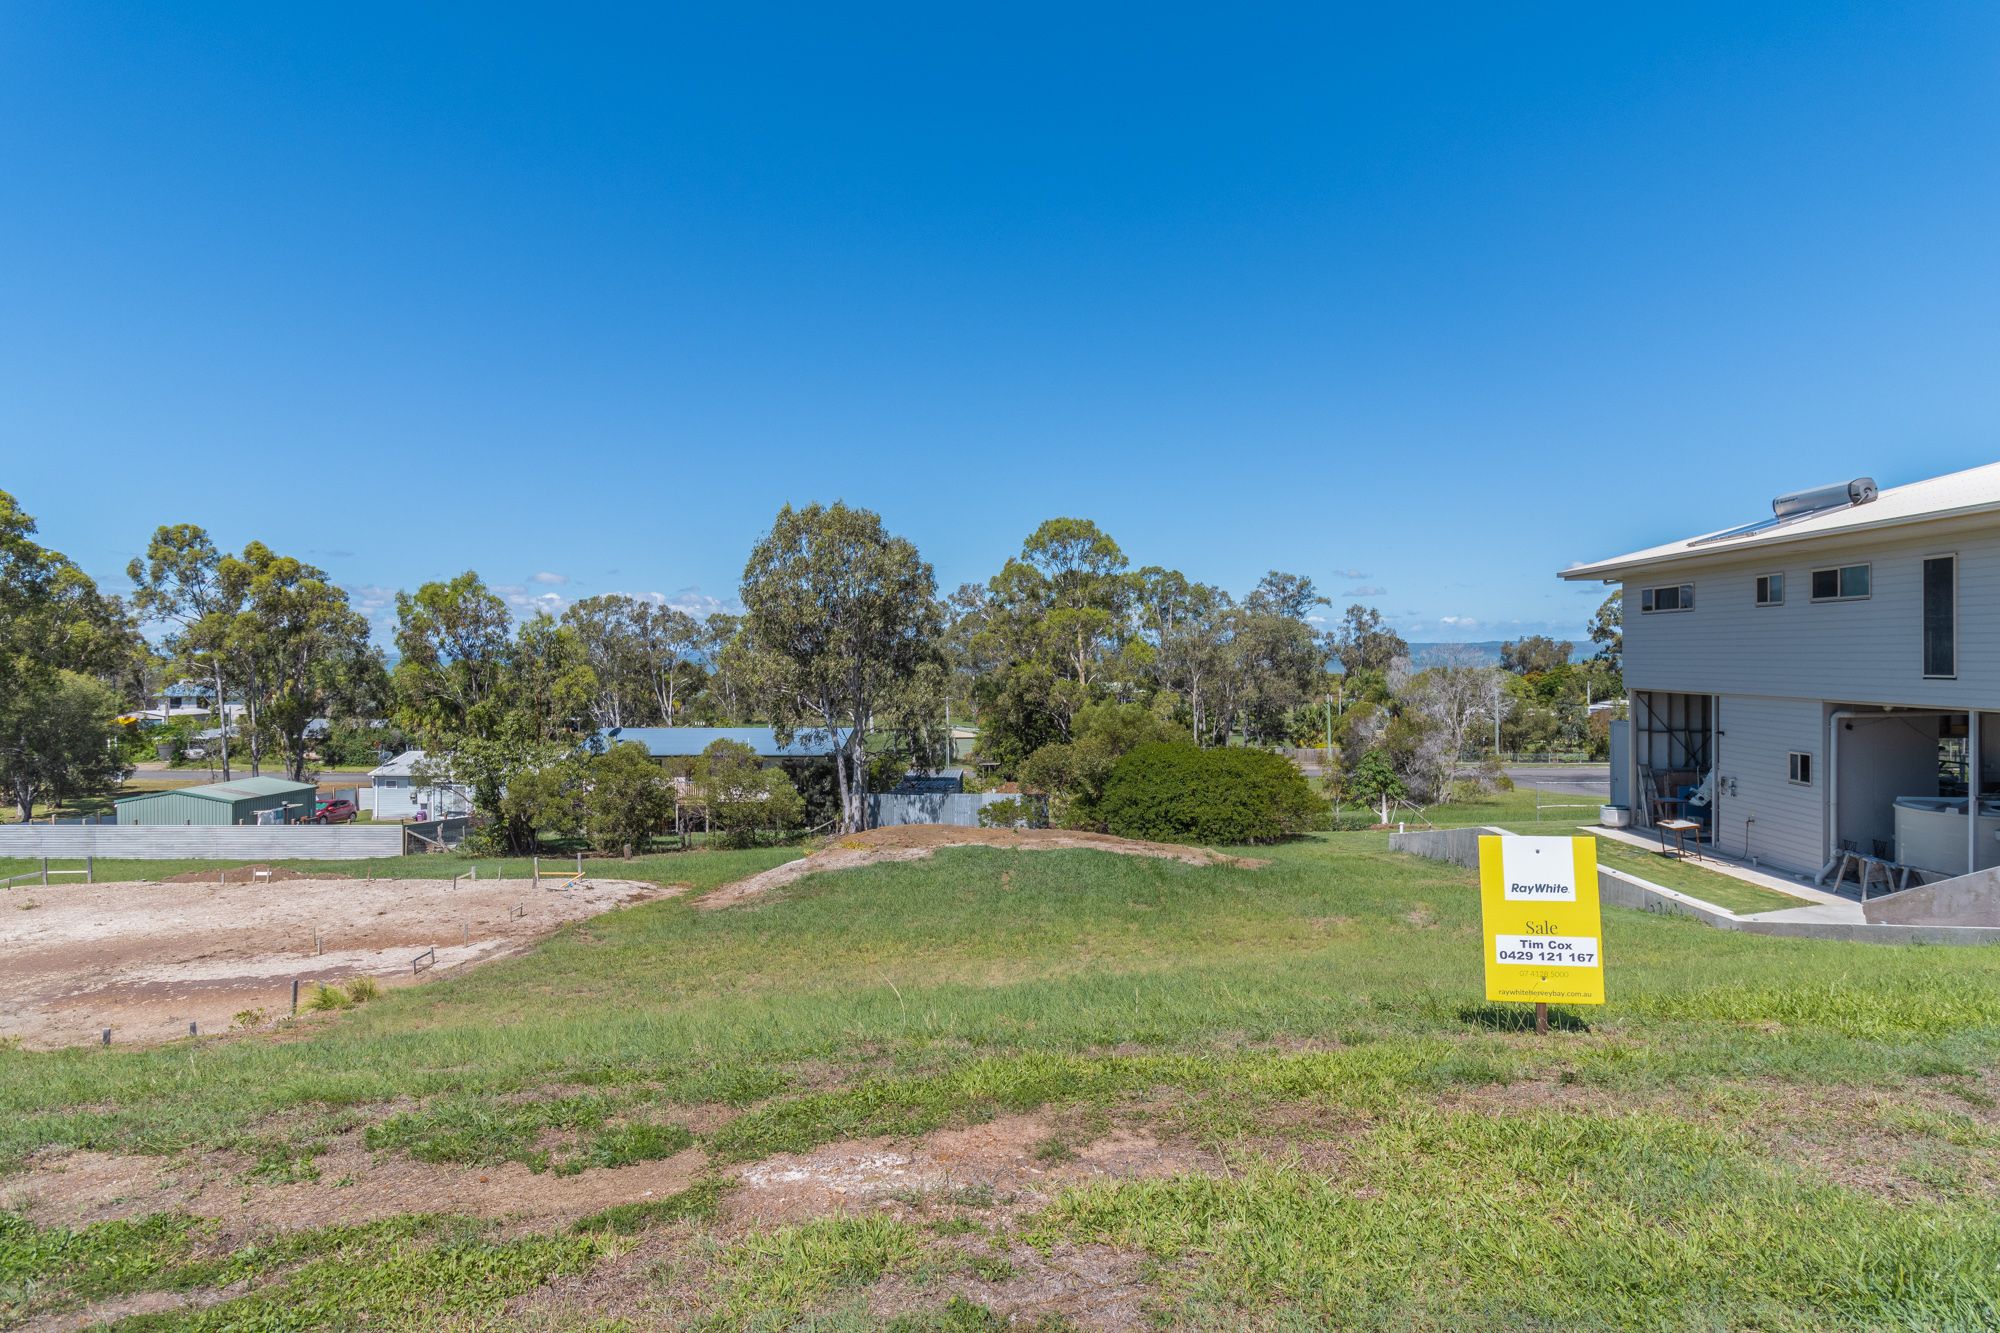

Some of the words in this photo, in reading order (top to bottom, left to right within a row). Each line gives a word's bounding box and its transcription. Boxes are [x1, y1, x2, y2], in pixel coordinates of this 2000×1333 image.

[1525, 920, 1558, 935] Sale
[1520, 940, 1544, 949] Tim
[1548, 940, 1573, 950] Cox
[1499, 950, 1533, 961] 0429
[1539, 952, 1563, 962] 121
[1569, 953, 1594, 963] 167
